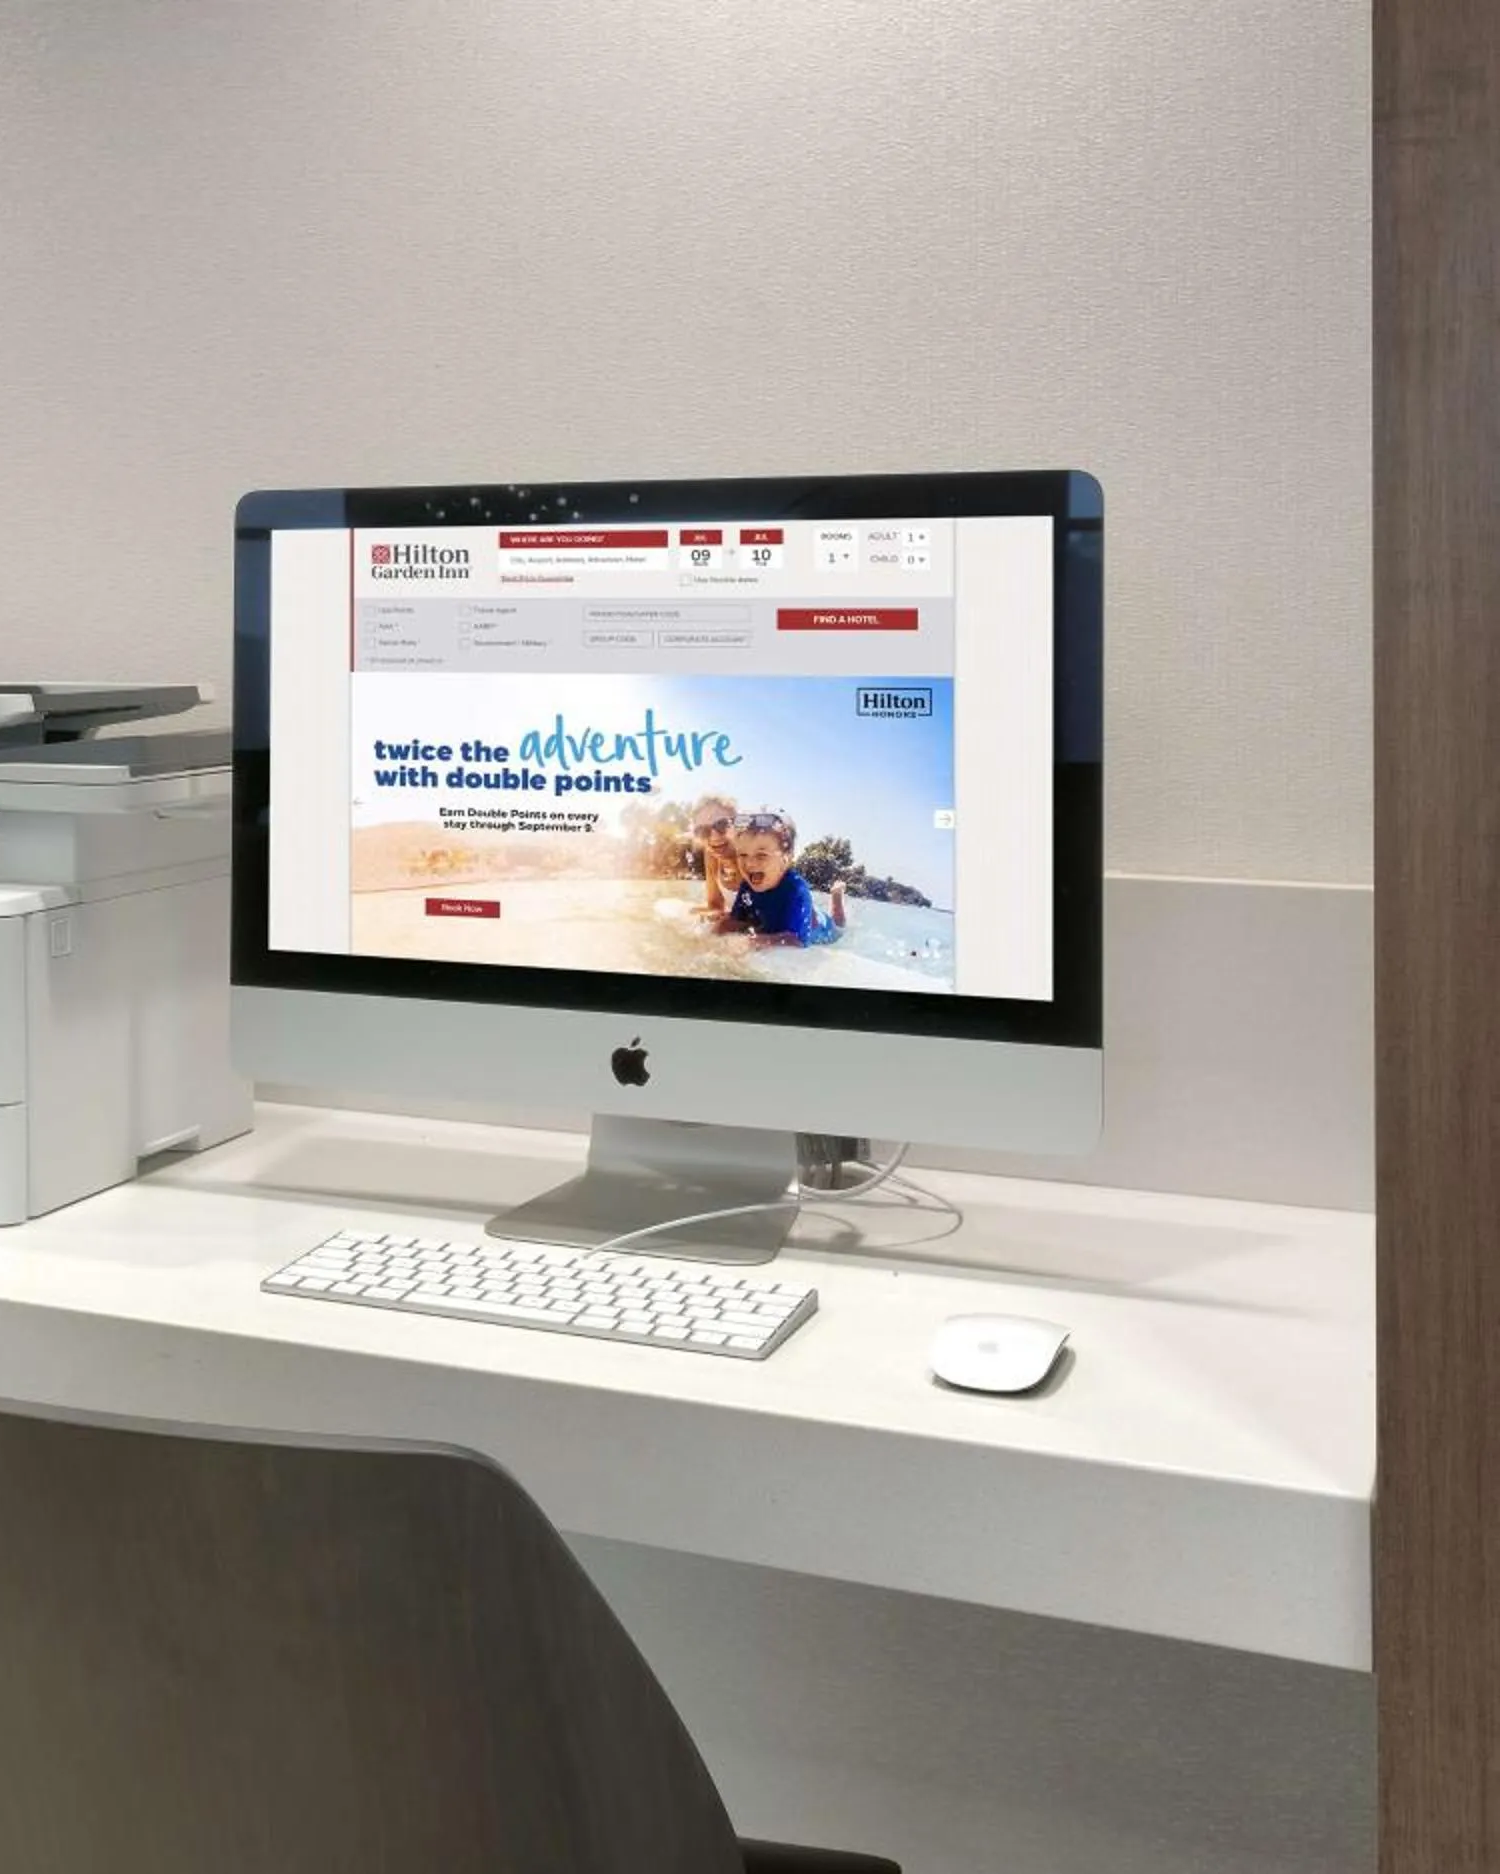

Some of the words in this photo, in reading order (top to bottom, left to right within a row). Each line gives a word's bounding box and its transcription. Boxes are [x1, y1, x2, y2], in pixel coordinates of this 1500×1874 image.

[393, 543, 469, 565] Hilton
[691, 549, 711, 561] 09
[752, 548, 772, 561] 10
[828, 552, 836, 564] 1
[907, 555, 915, 565] 0
[371, 565, 436, 580] Garden
[438, 565, 470, 580] Inn
[813, 615, 837, 624] FIND
[838, 615, 846, 624] A
[847, 615, 880, 624] HOTEL
[863, 693, 925, 709] Hilton
[374, 738, 453, 762] twice
[460, 740, 510, 763] the
[519, 708, 743, 777] adventure
[374, 765, 438, 788] with
[445, 766, 547, 791] double
[554, 769, 652, 796] points
[439, 807, 465, 817] Earn
[467, 807, 508, 819] Double
[510, 809, 547, 820] Points
[549, 811, 564, 821] on
[567, 812, 599, 823] every
[443, 820, 467, 831] stay
[469, 820, 516, 833] through
[518, 821, 582, 833] September
[584, 823, 595, 833] 9.
[441, 903, 462, 912] Book
[463, 905, 484, 913] Now
